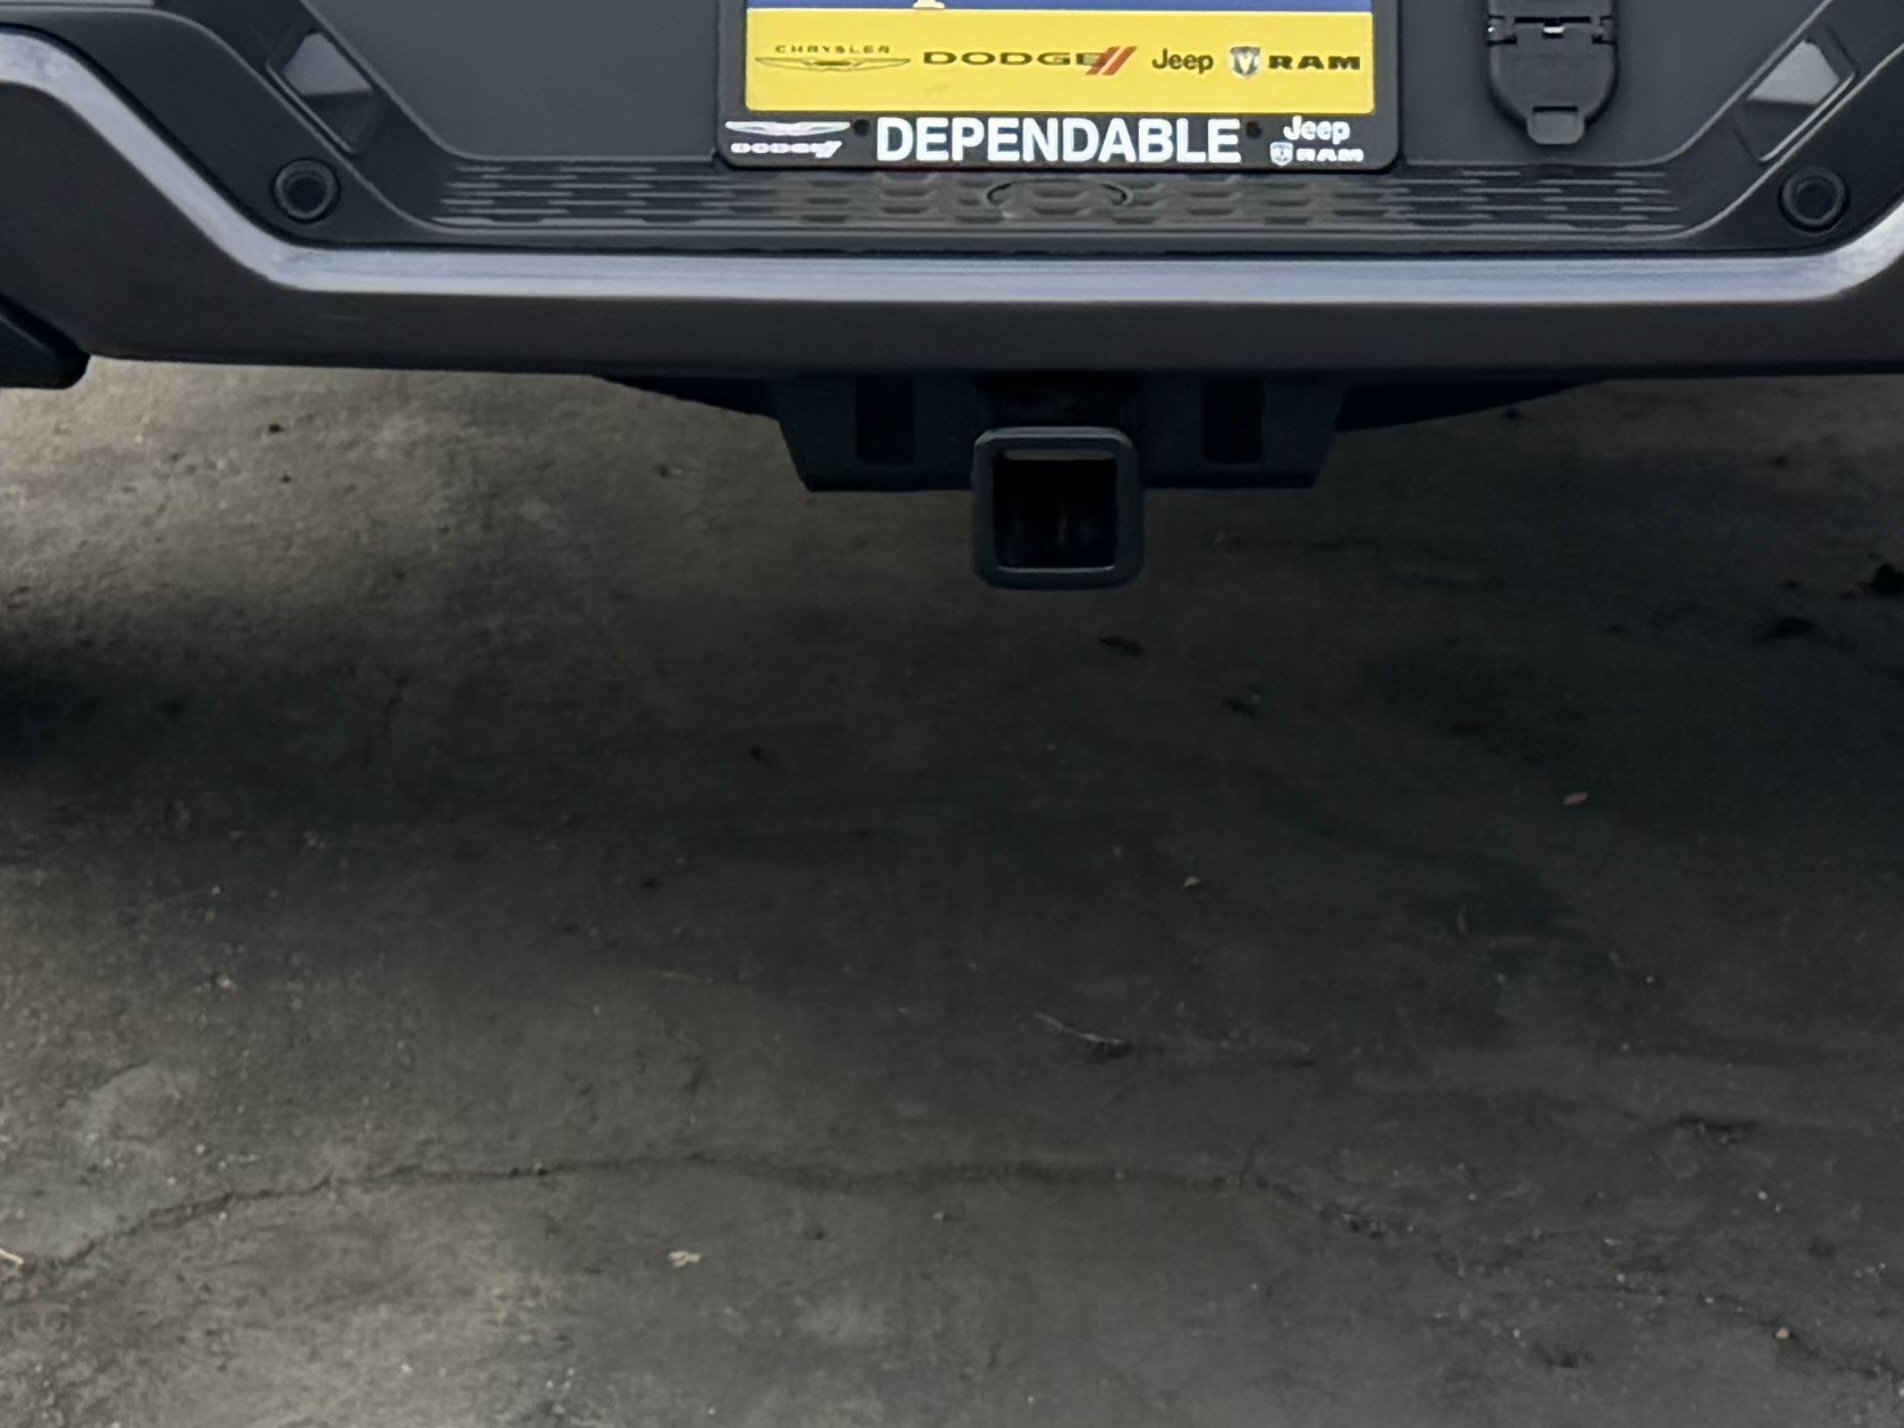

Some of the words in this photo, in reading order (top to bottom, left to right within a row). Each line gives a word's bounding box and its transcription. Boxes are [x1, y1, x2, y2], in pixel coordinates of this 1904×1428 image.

[775, 44, 890, 54] CHRYSLER
[923, 51, 1102, 66] DODGE
[1152, 48, 1214, 74] Jeep
[1268, 55, 1361, 70] RAM
[1283, 115, 1350, 145] Jeep
[876, 118, 1241, 164] DEPENDABLE
